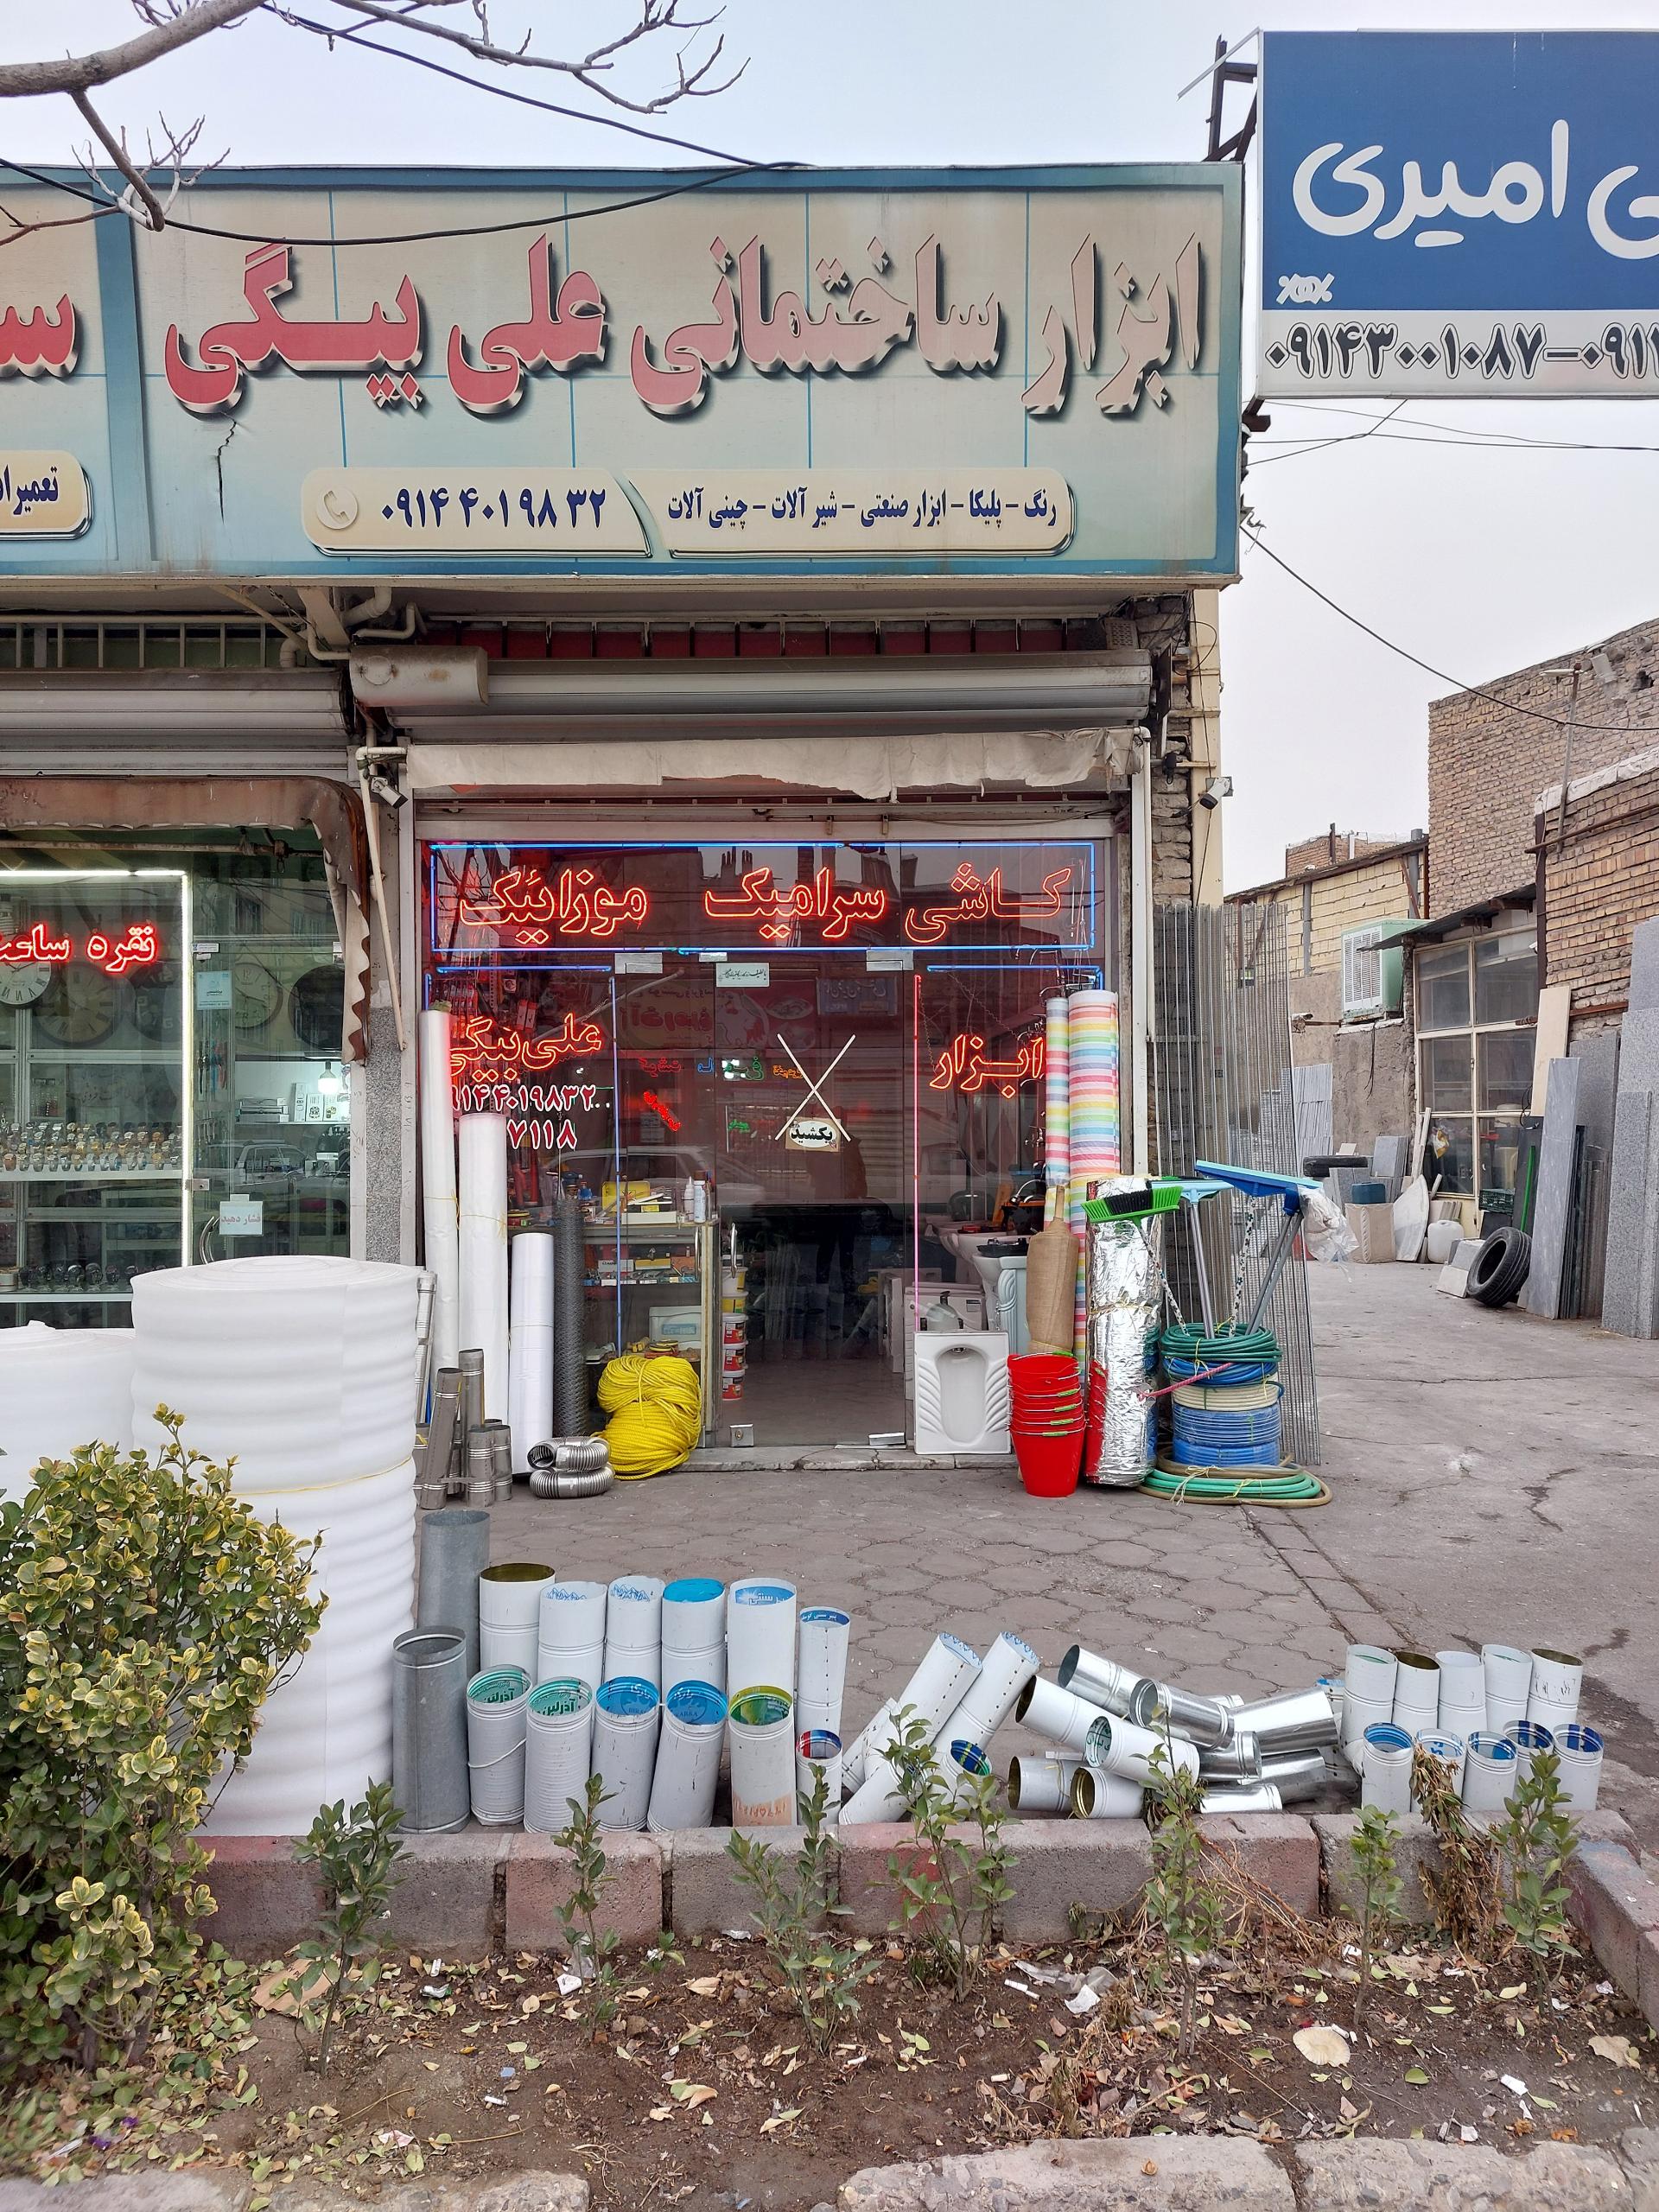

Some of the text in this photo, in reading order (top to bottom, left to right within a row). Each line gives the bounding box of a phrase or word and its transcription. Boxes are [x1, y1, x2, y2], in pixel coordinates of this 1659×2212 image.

[1293, 118, 1569, 248] امیری
[447, 232, 606, 413] علی
[630, 234, 1002, 415] ساختمانی
[1020, 232, 1202, 415] ابزار
[0, 464, 59, 515] تعمیرا
[668, 486, 1058, 530] رنگ پلیکا ابزار صنعتی شیر آلات چینی آلات
[705, 867, 886, 939] سرامیک
[905, 862, 1071, 944] کاشی
[87, 925, 156, 972] نقره
[522, 1013, 602, 1070] علی
[791, 1126, 833, 1144] بکشید
